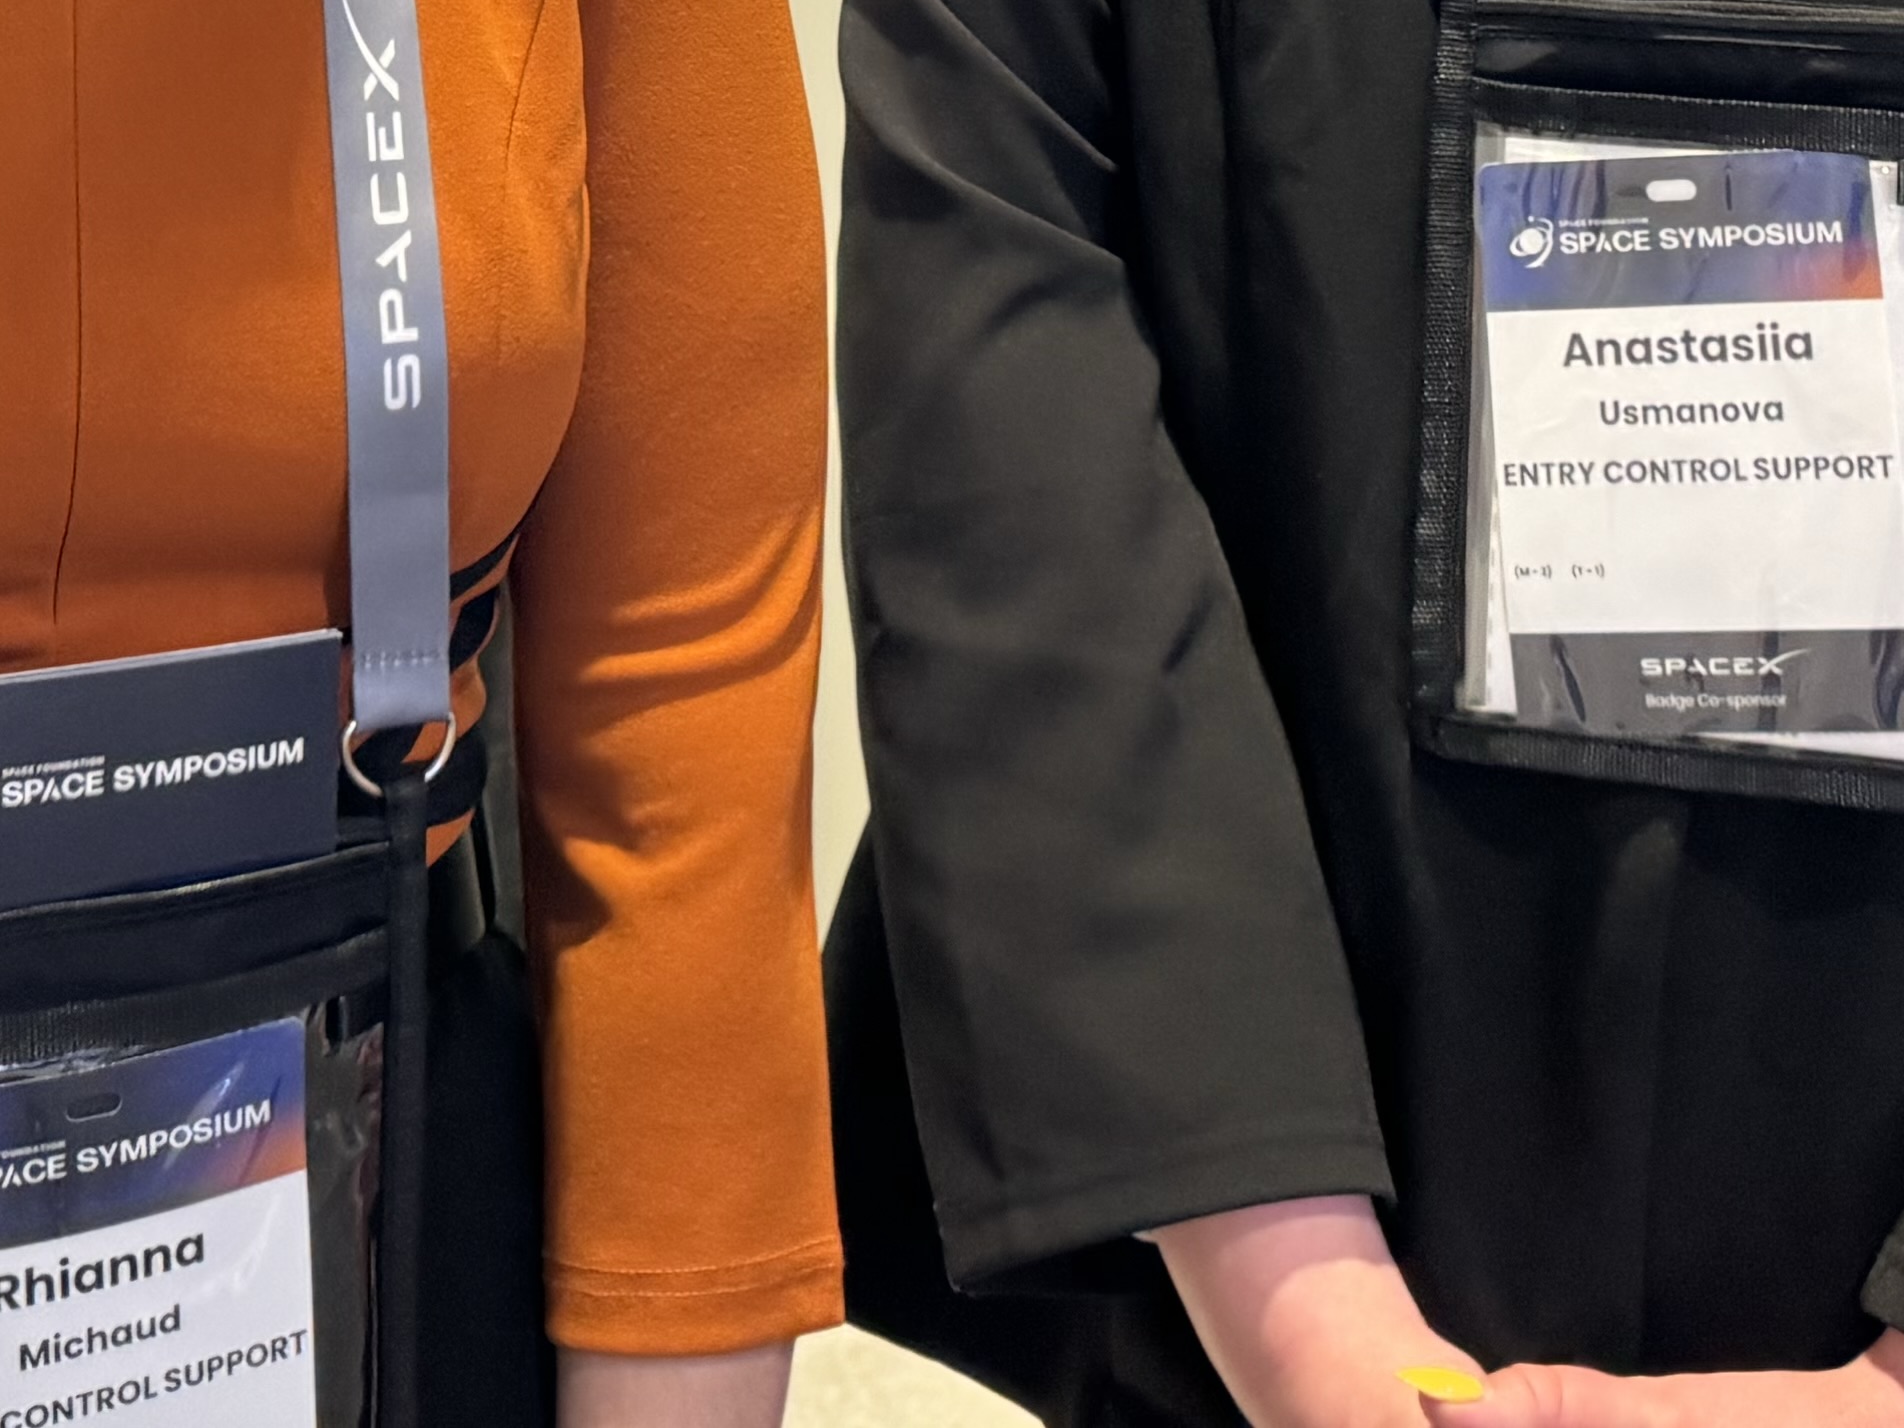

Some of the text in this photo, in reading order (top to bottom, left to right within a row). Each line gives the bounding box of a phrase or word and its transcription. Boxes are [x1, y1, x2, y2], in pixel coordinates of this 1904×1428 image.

[1559, 220, 1844, 255] SPACE SYMPOSIUM
[1562, 322, 1814, 368] Anastasiia
[1599, 400, 1785, 426] Usmanova
[1503, 454, 1895, 488] ENTRY CONTROL SUPPORT
[1640, 647, 1813, 676] SPACEX
[1645, 692, 1695, 713] Badge
[0, 736, 305, 809] SPACE SYMPOSIUM
[76, 1098, 272, 1174] SYMPOSIUM
[19, 1304, 182, 1372] Michaud
[164, 1329, 308, 1393] SUPPORT
